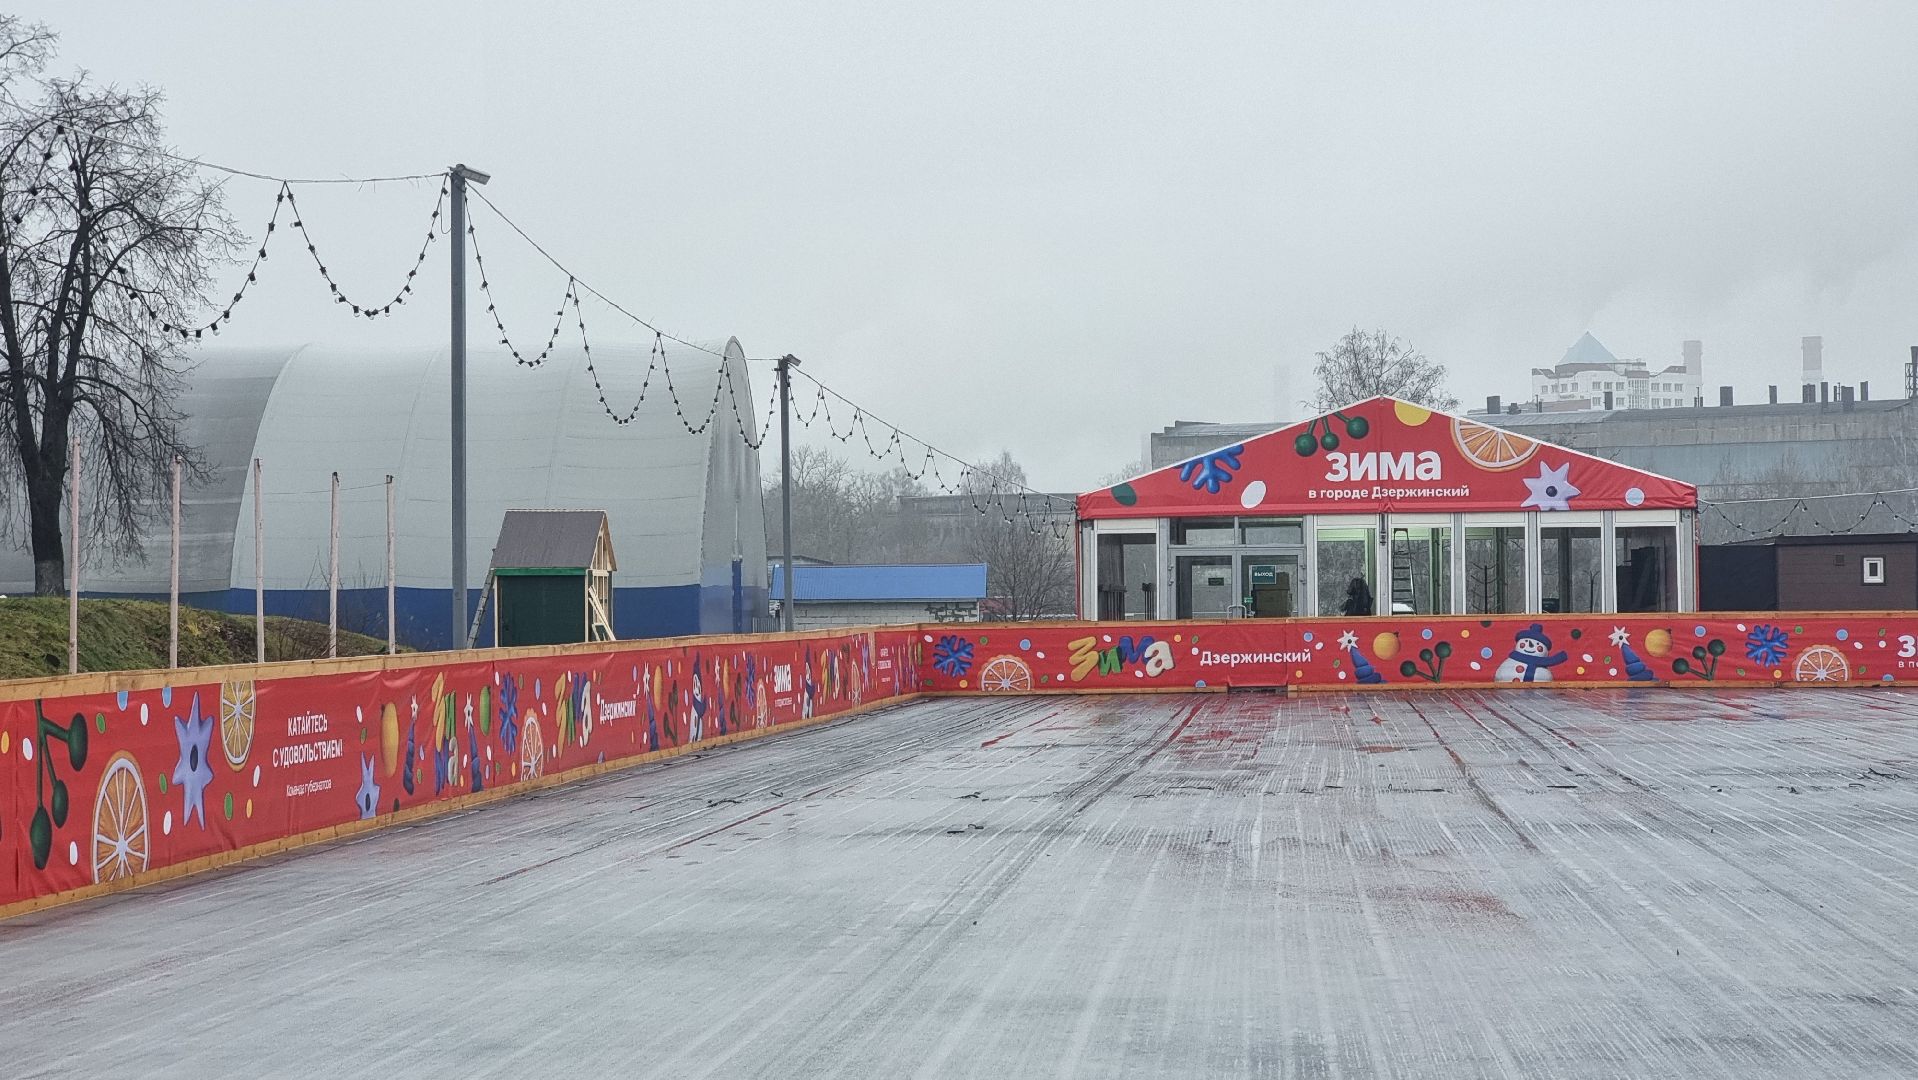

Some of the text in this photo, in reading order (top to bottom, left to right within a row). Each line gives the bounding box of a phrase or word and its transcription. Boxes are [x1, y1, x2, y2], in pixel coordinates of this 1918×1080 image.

[1308, 485, 1470, 501] в городе Дзержинский
[1068, 636, 1311, 682] Зима Дзержинский
[287, 711, 327, 736] КАТАЙТЕСЬ
[272, 739, 343, 768] С УДОВОЛЬСТВИЕМ!
